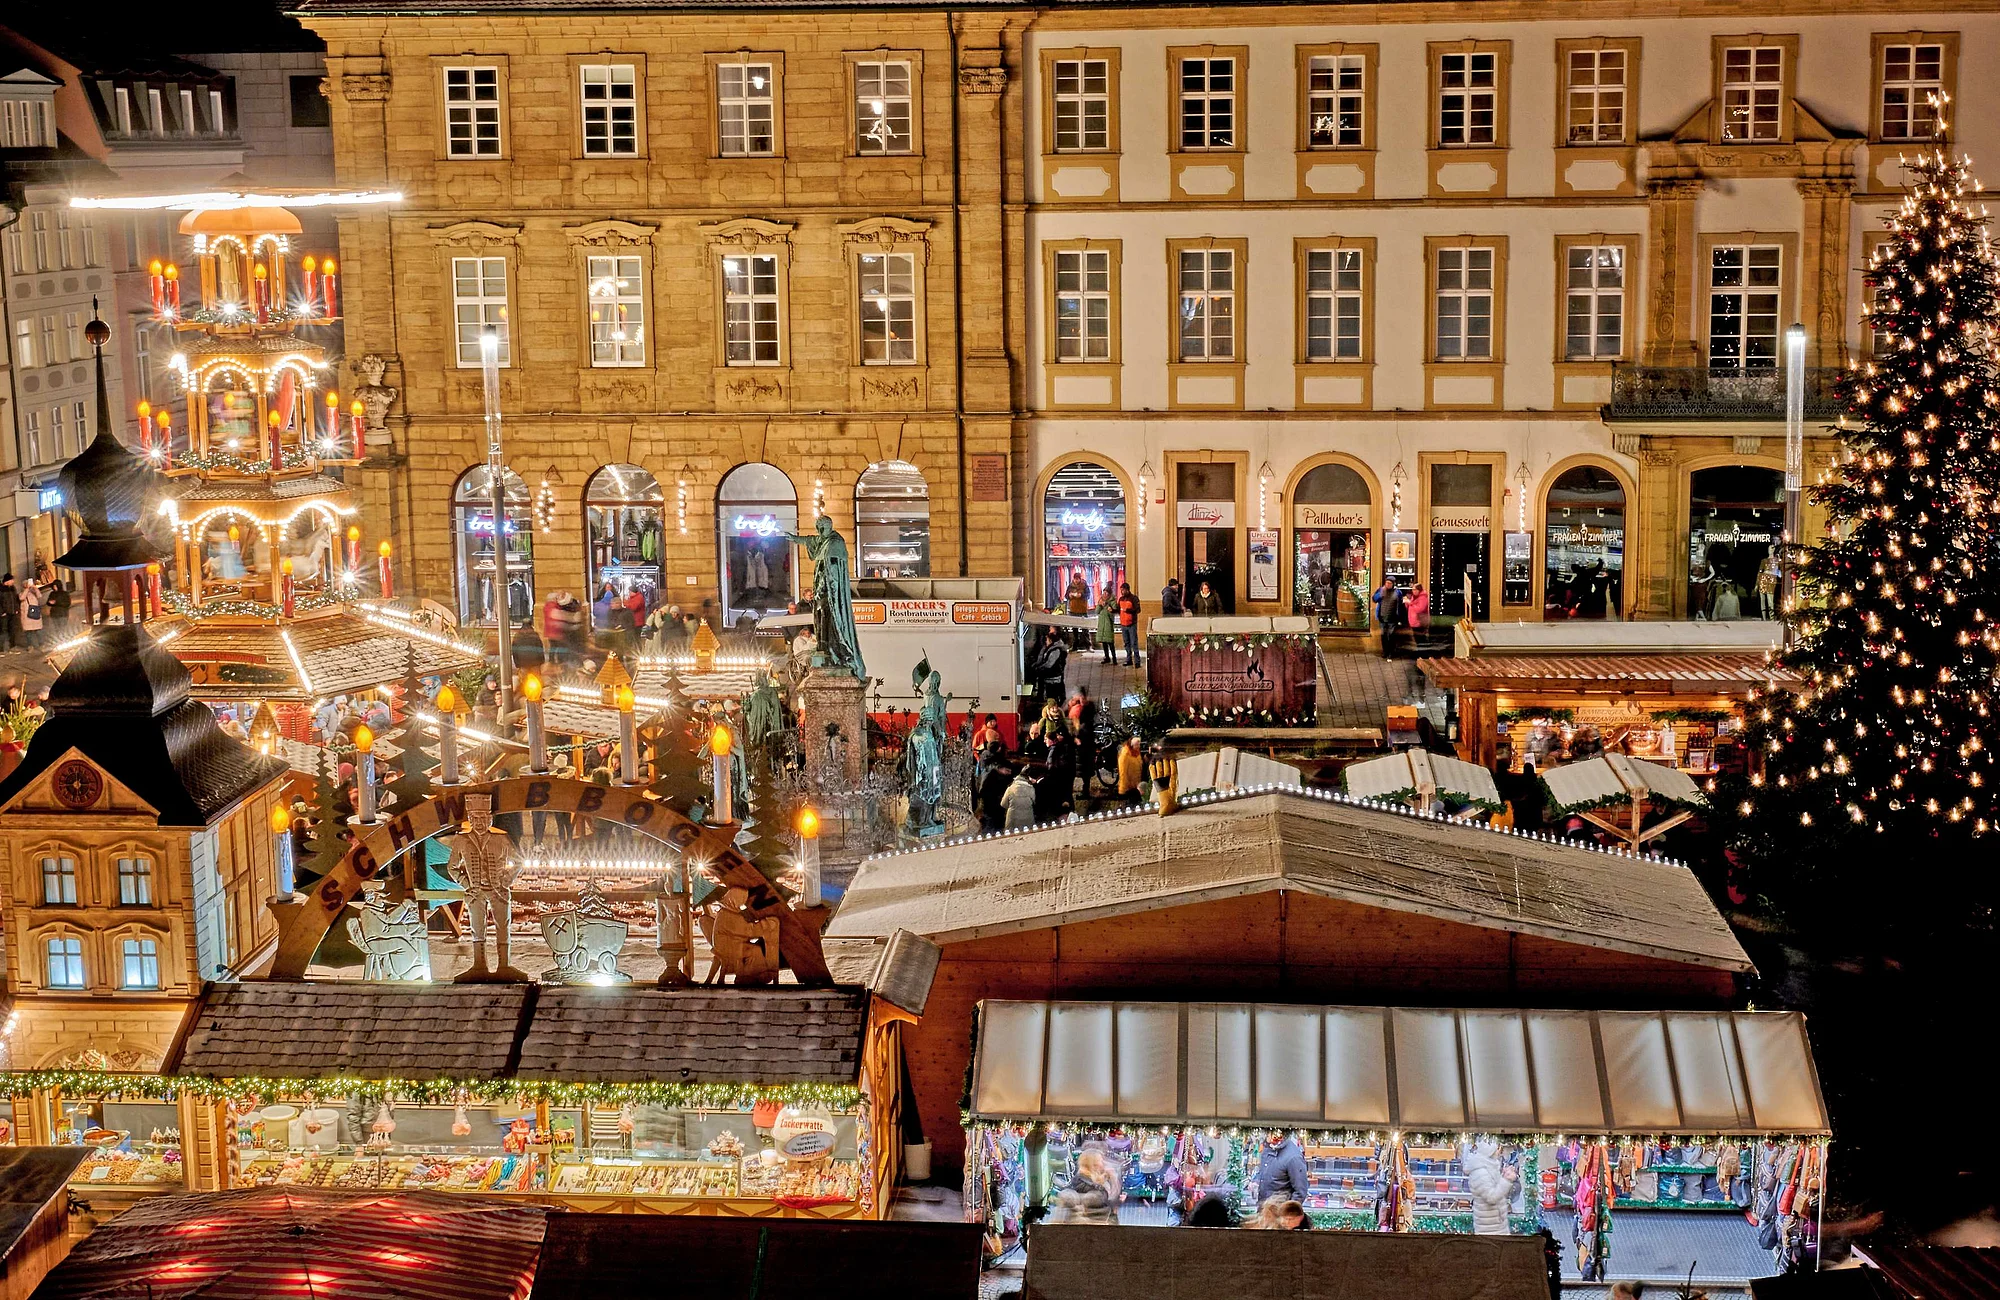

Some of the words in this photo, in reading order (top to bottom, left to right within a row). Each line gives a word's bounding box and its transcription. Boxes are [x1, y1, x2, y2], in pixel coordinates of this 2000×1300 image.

[1062, 508, 1105, 532] tredy
[1302, 507, 1363, 525] Pallhuber's
[1431, 515, 1490, 528] Genusswelt
[734, 515, 779, 536] tredy
[1552, 532, 1581, 542] FRAUEN
[1588, 533, 1618, 542] ZIMMER
[1704, 532, 1733, 542] FRAUEN
[1740, 533, 1771, 543] ZIMMER
[891, 601, 946, 609] HACKER'S
[889, 609, 949, 617] Rostbratwürste
